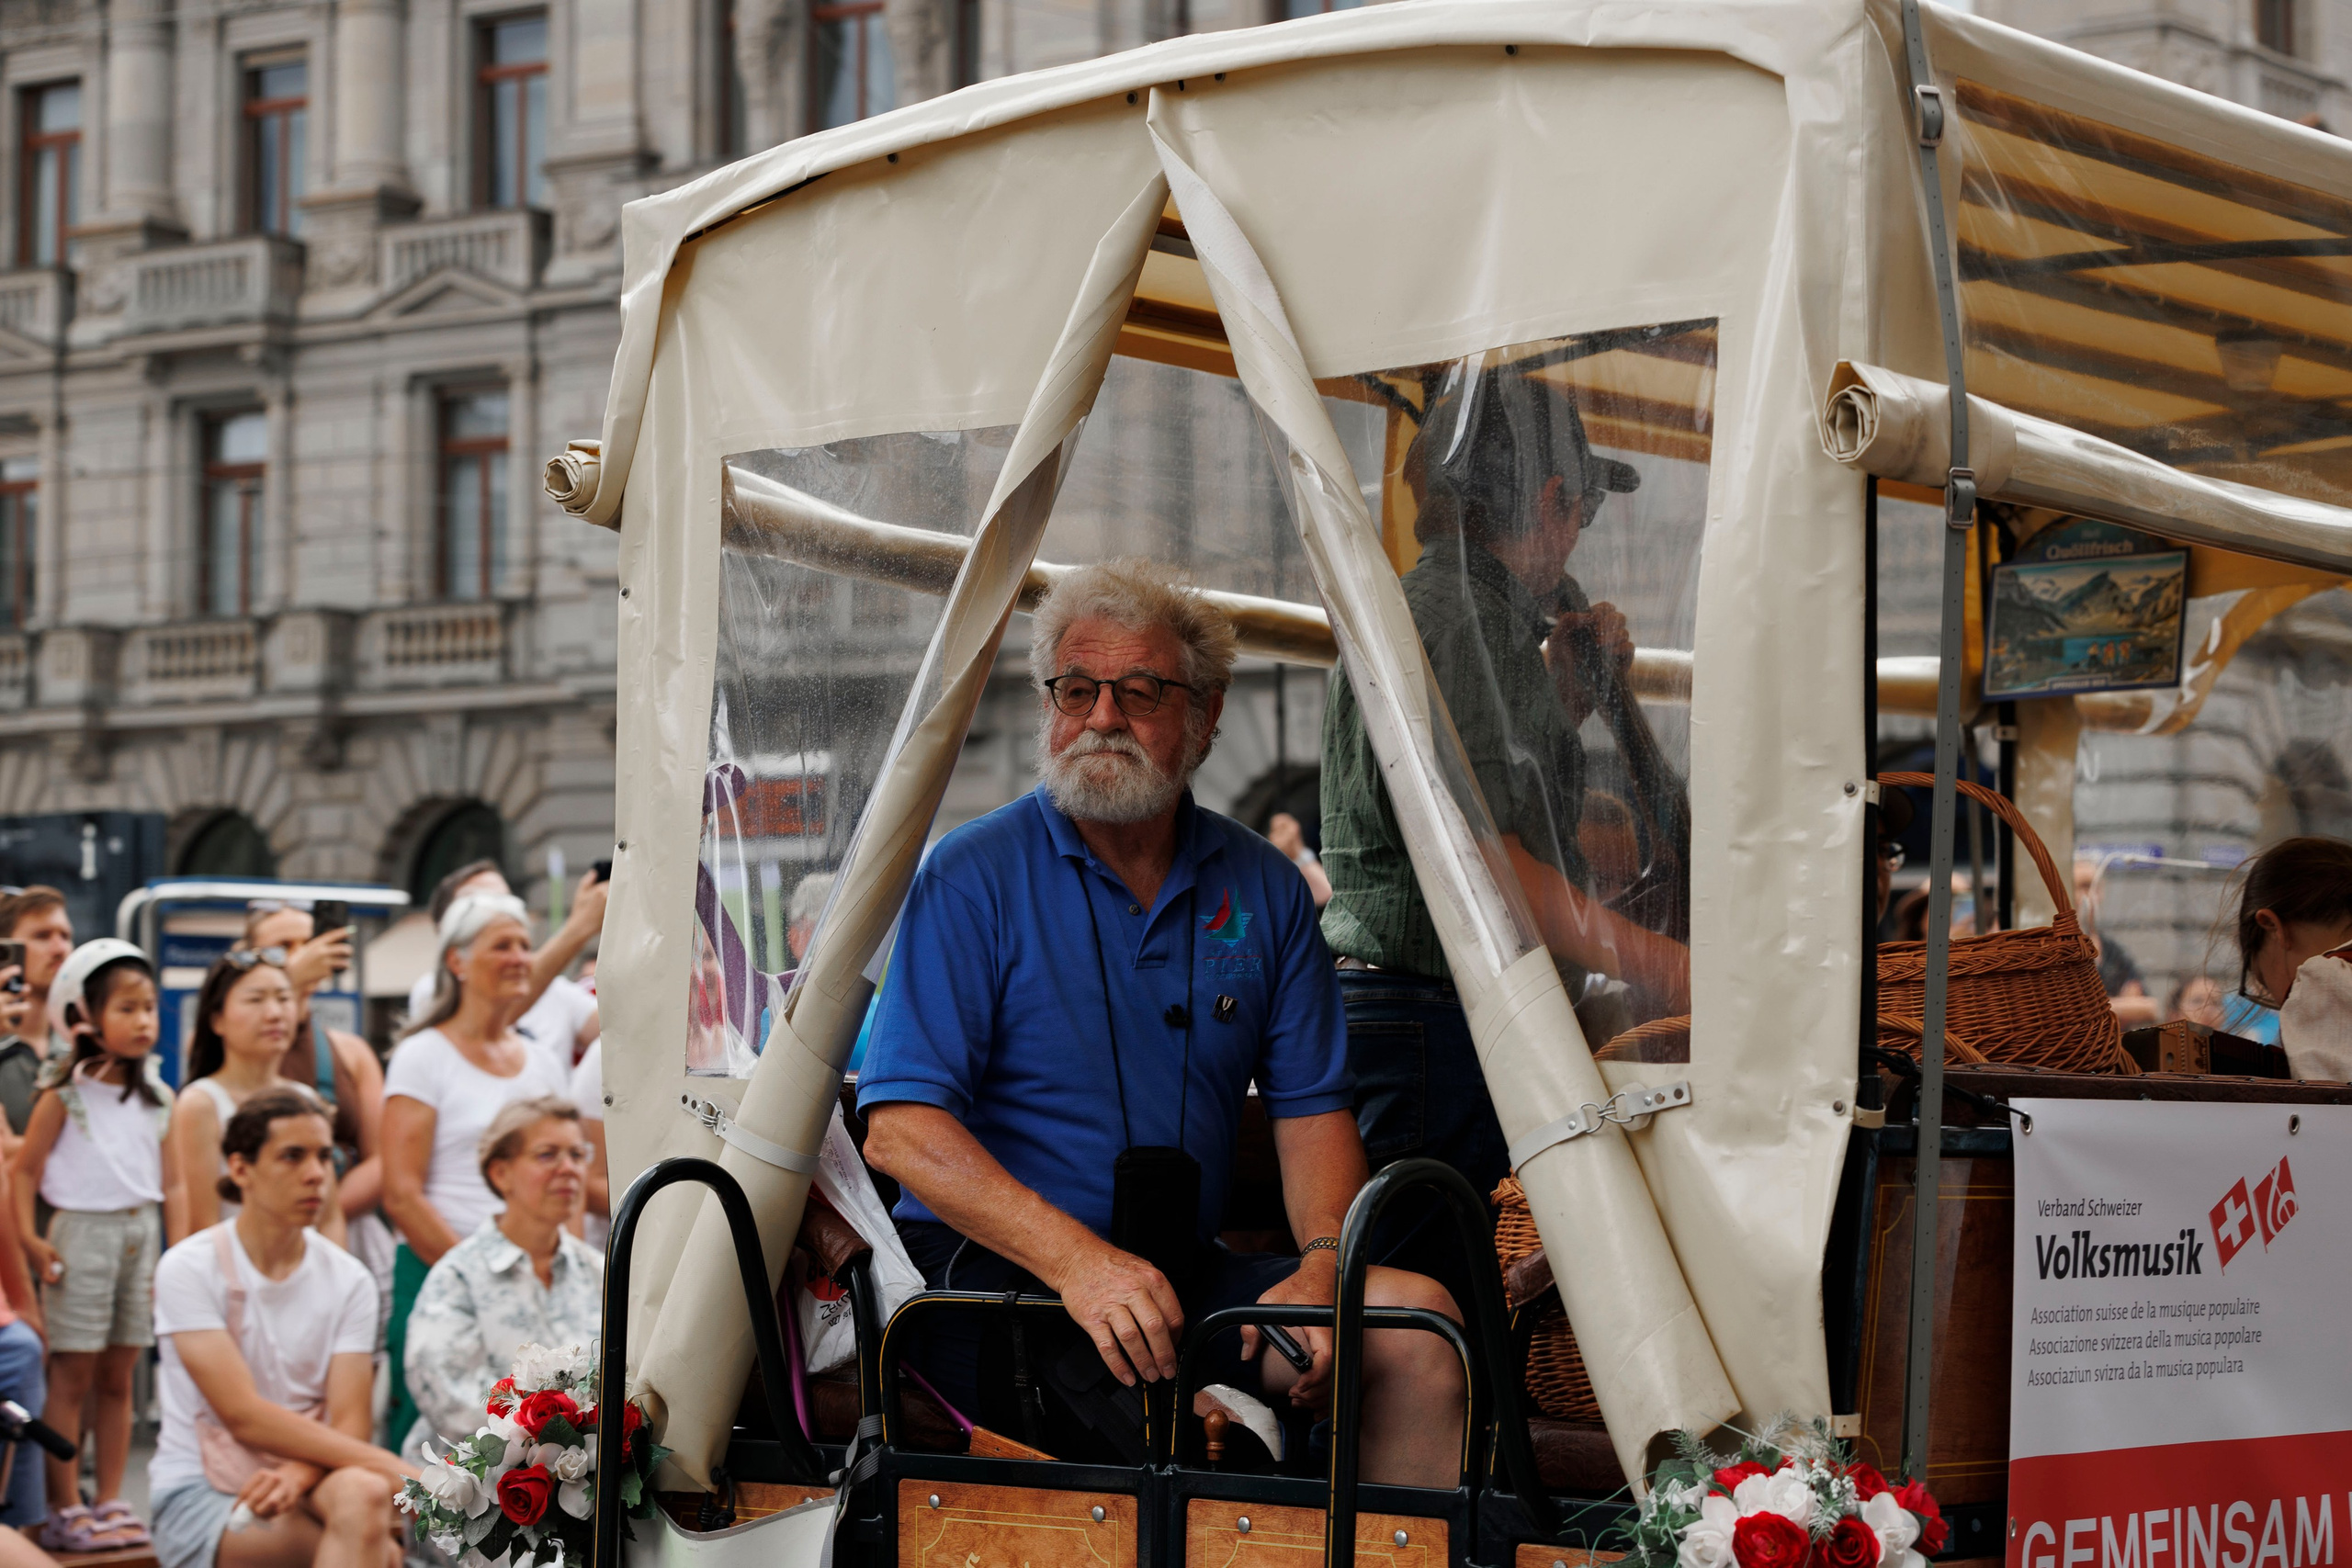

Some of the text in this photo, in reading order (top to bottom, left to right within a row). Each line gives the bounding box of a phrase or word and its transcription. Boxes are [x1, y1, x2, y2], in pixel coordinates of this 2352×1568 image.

[1204, 957, 1261, 974] PIER
[2038, 1198, 2143, 1217] Verband Schweizer
[2035, 1228, 2204, 1280] Volksmusik
[2030, 1297, 2260, 1325] Association suisse de la musique populaire
[2029, 1325, 2262, 1355] Associazione svizzera della musica popolare
[2027, 1356, 2244, 1386] Associaziun svizra da la musica populara
[2022, 1494, 2335, 1568] GEMEINSAM
